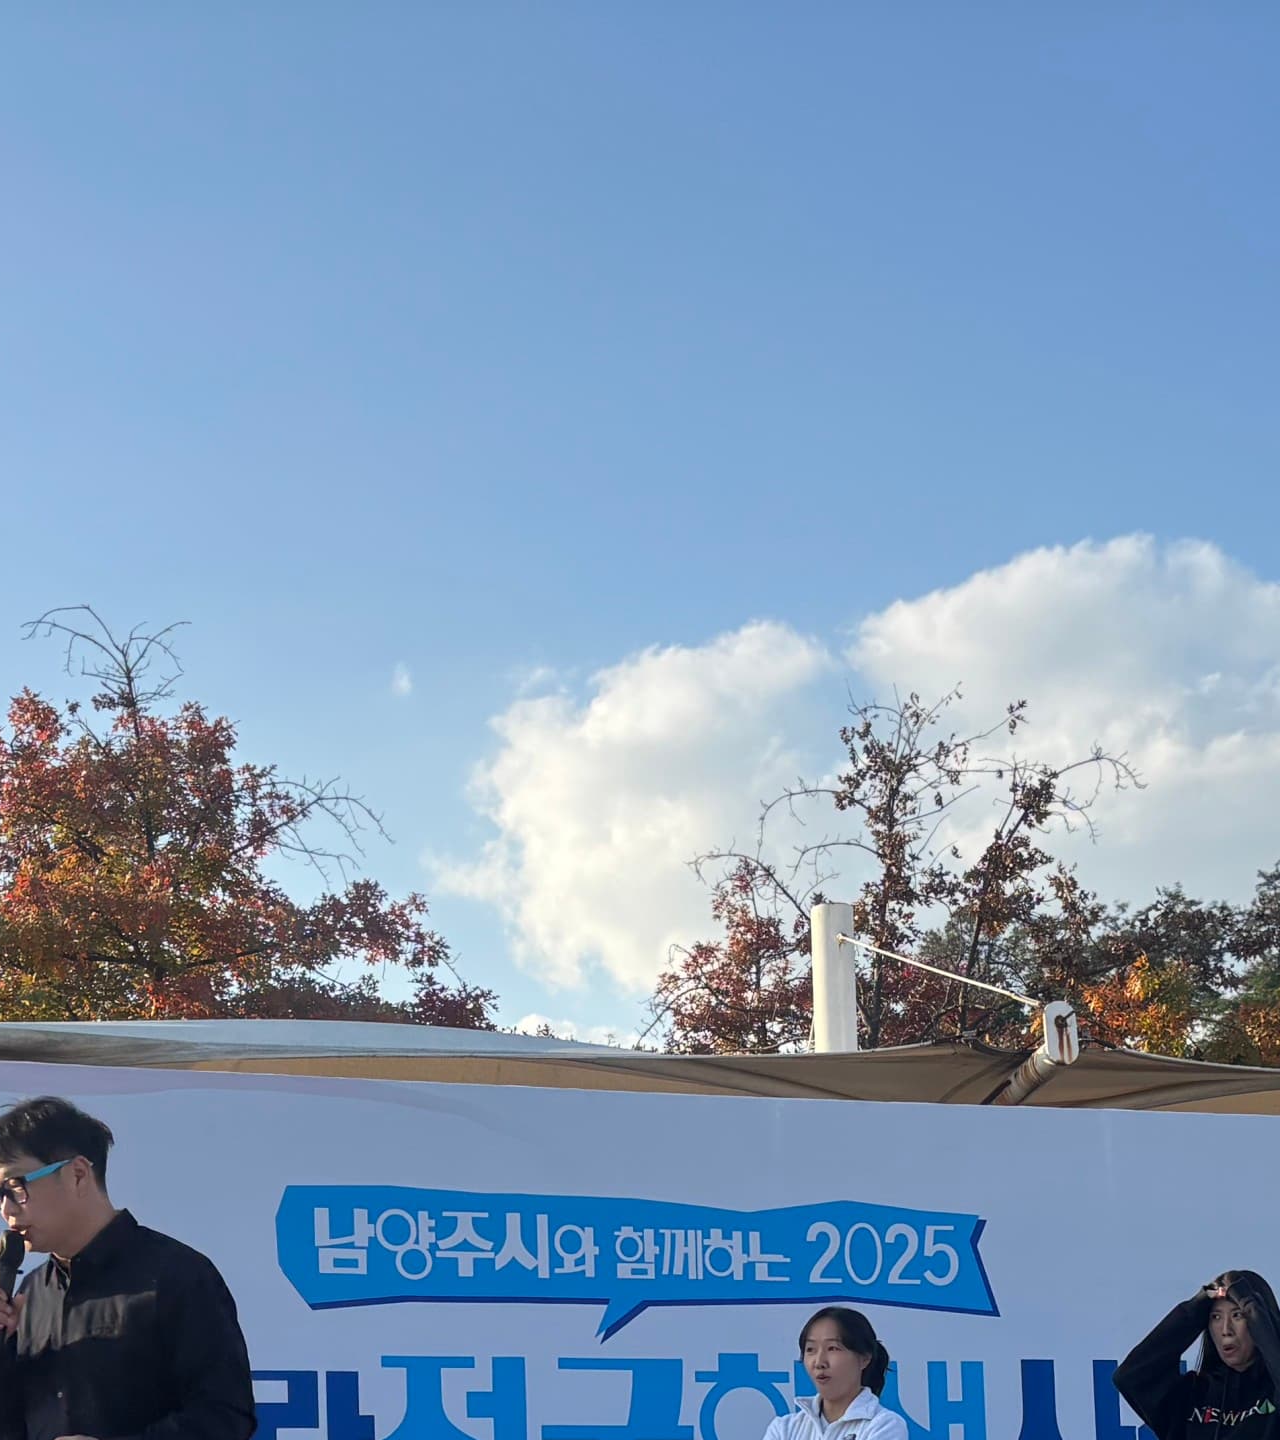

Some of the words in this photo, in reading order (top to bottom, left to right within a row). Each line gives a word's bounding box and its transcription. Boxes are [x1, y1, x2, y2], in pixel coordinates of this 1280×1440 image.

[313, 1207, 599, 1281] 남양주시와
[615, 1226, 791, 1282] 함께하는
[807, 1221, 960, 1287] 2025
